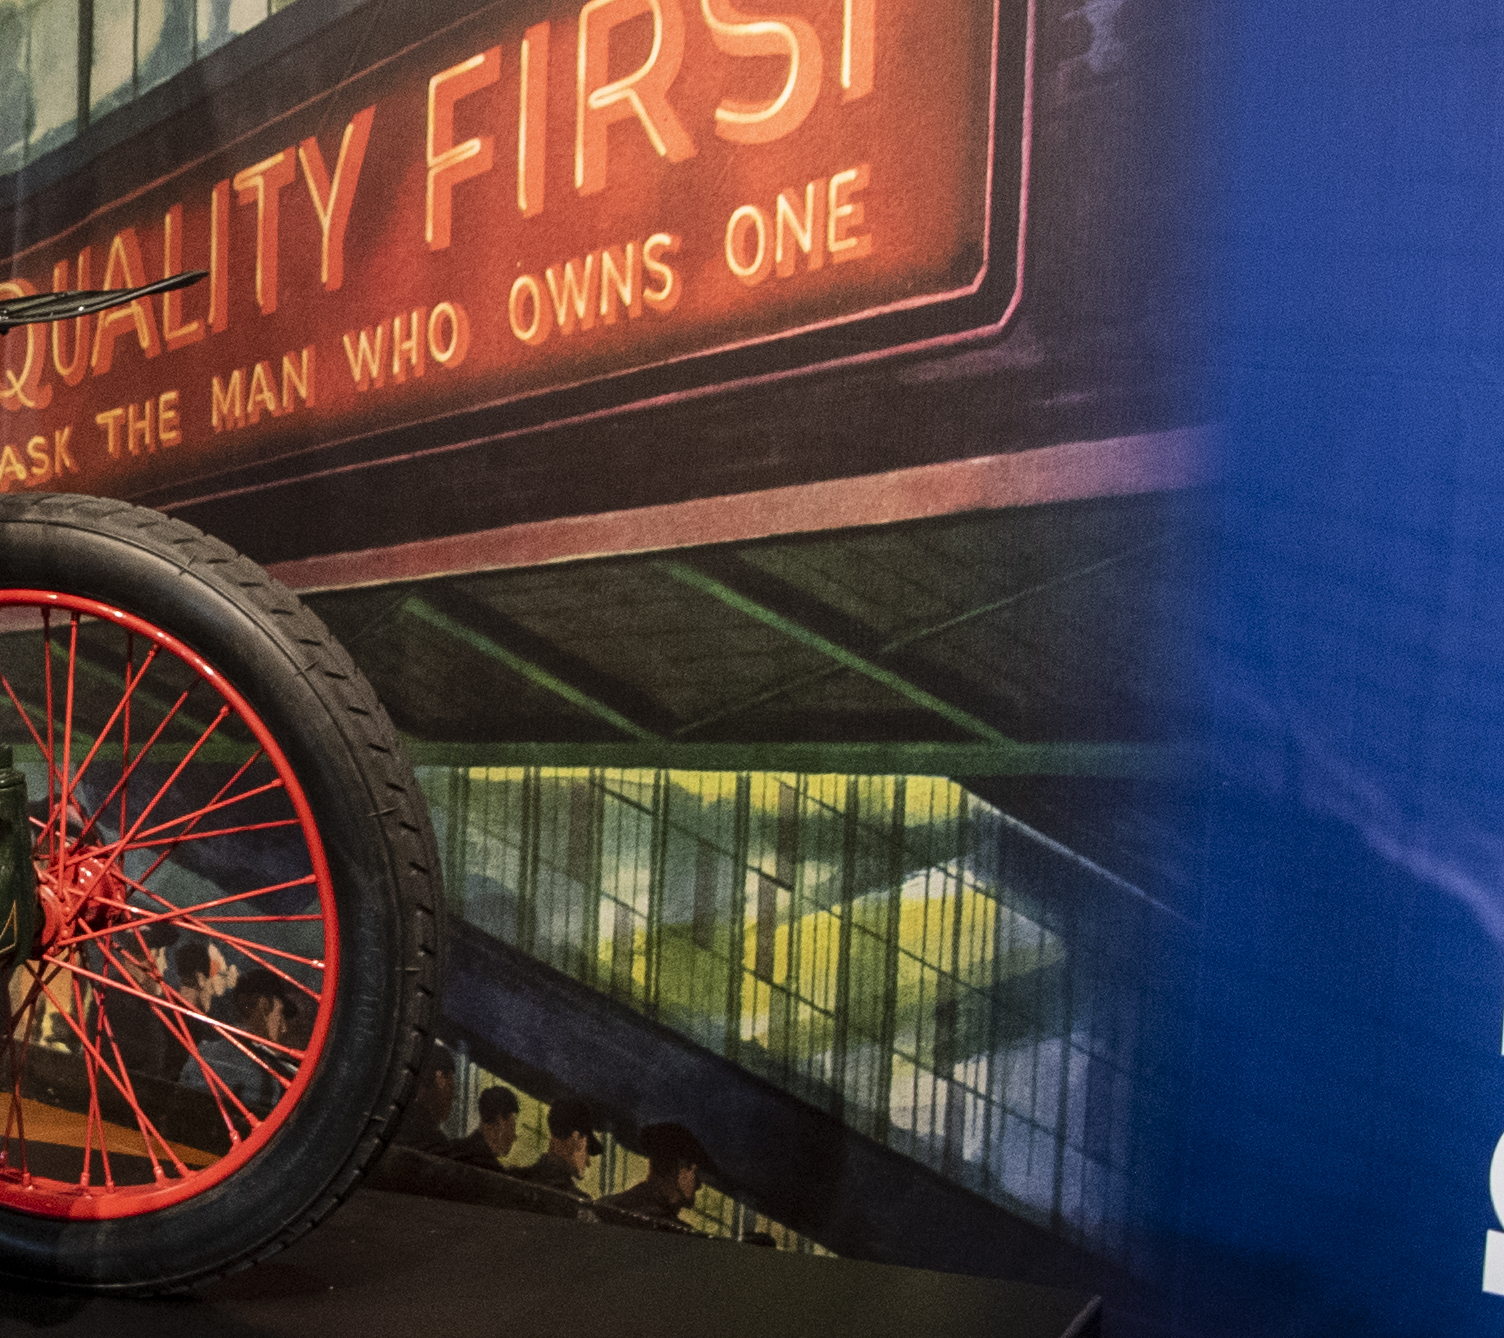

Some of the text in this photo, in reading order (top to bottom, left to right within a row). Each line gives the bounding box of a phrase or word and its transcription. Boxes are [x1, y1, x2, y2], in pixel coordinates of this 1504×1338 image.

[95, 390, 182, 459] THE
[211, 345, 317, 433] MAN
[343, 302, 470, 393] WHO
[508, 231, 682, 347] OWNS
[725, 163, 873, 279] ONE
